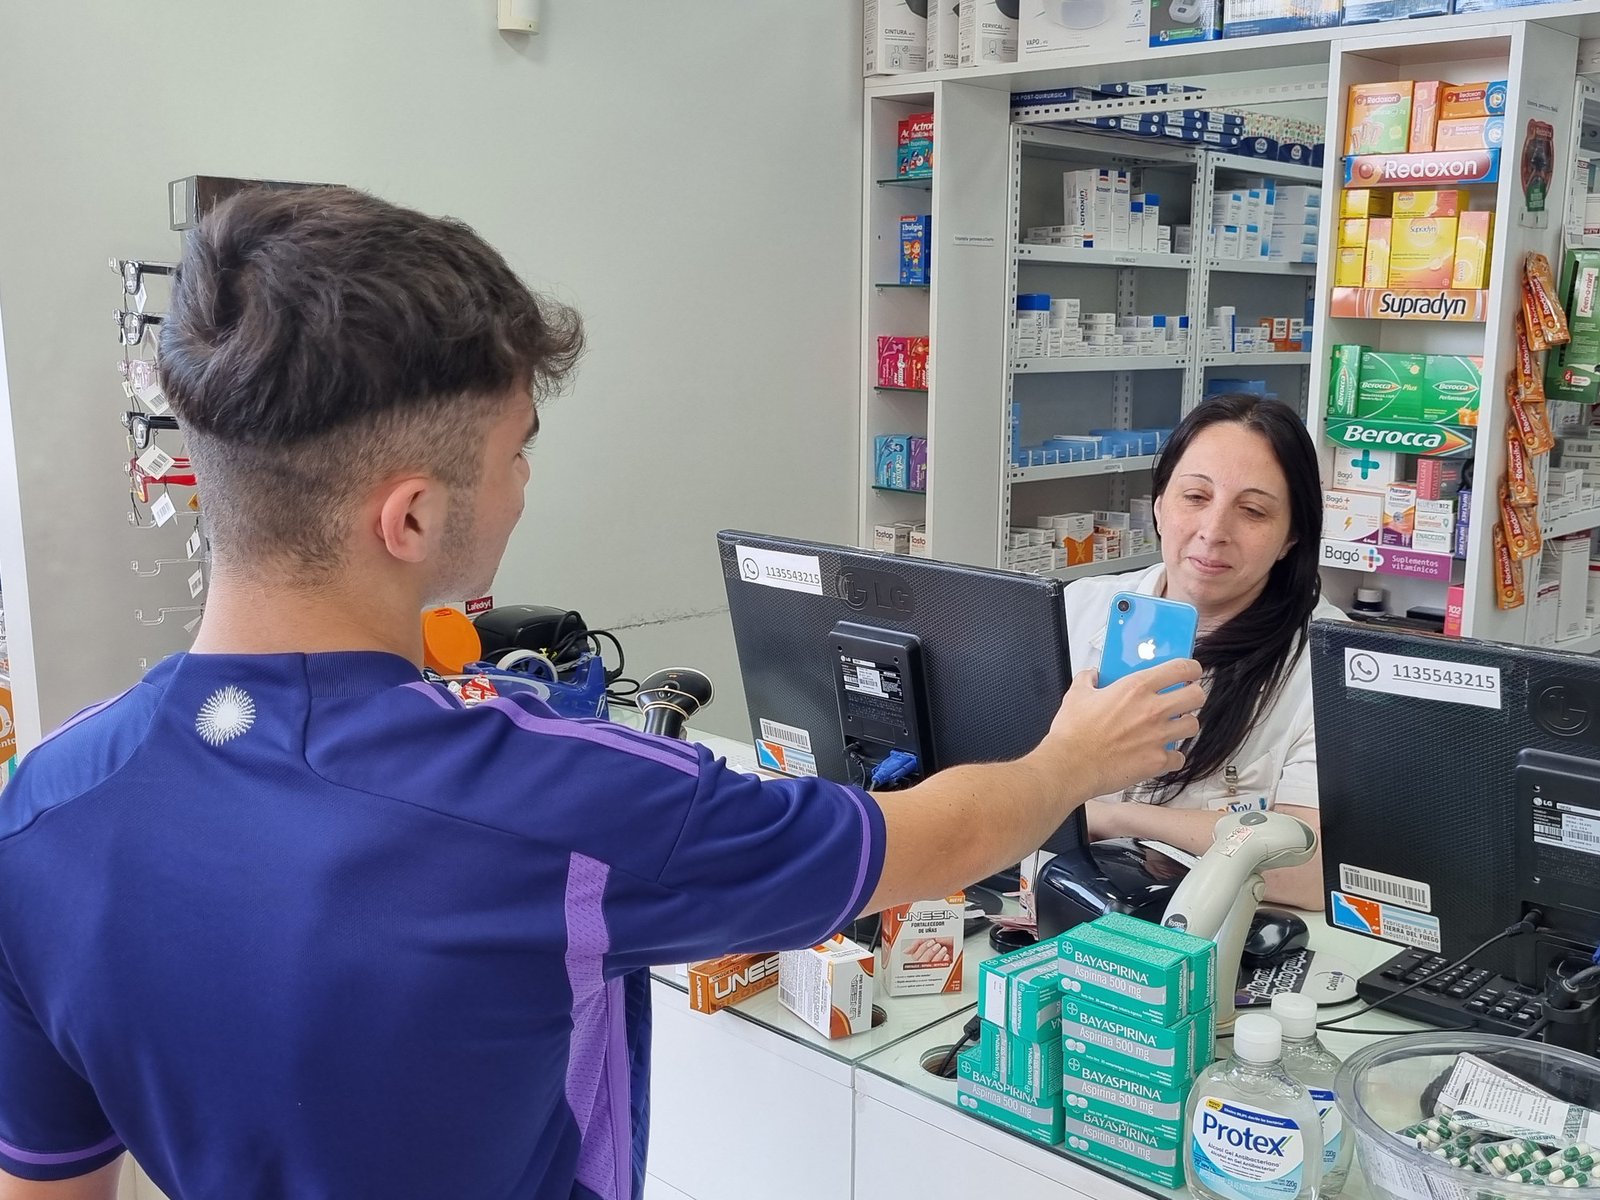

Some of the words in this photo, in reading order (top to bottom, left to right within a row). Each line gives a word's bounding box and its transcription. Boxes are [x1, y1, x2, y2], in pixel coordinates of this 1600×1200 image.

[981, 22, 1004, 30] CERVICAL
[1366, 94, 1398, 105] Redoxon
[1384, 158, 1477, 179] Redoxon
[1409, 225, 1436, 234] Supradyn
[1379, 292, 1467, 320] Supradyn
[1338, 375, 1346, 406] Berocca
[1361, 381, 1392, 390] Berocca
[1439, 383, 1469, 391] Berocca
[1343, 425, 1442, 448] Berocca
[1513, 440, 1525, 481] Redoxitos
[1325, 495, 1343, 504] Bagó
[911, 535, 926, 545] Tosto
[1324, 545, 1360, 565] Bagó
[1392, 554, 1439, 567] Suplementos
[1503, 546, 1514, 586] Redoxitos
[765, 566, 821, 586] 1135543215
[1391, 562, 1438, 575] vitamínicos
[1392, 664, 1496, 690] 1135543215
[896, 910, 959, 922] UNESIA
[1383, 924, 1404, 935] TIERRA
[1406, 930, 1418, 938] DEL
[1419, 932, 1440, 944] FUEGO
[714, 953, 780, 1000] UNES
[1074, 950, 1150, 985] BAYASPIRINA
[1074, 965, 1107, 984] Aspirina
[1109, 976, 1127, 992] 500
[1128, 985, 1142, 999] mg
[849, 973, 859, 1021] UNESIA
[1080, 1012, 1157, 1047] BAYASPIRINA
[1079, 1026, 1113, 1046] Aspirina
[1115, 1038, 1133, 1054] 500
[1135, 1047, 1150, 1061] mg
[972, 1070, 1039, 1106] BAYASPIRINA
[1081, 1067, 1162, 1101] BAYASPIRINA
[972, 1084, 1001, 1104] Aspirina
[1003, 1095, 1018, 1111] 500
[1020, 1104, 1032, 1119] mg
[1081, 1081, 1117, 1101] Aspirina
[1119, 1092, 1137, 1108] 500
[1139, 1100, 1154, 1115] mg
[1083, 1113, 1159, 1147] BAYASPIRINA
[1202, 1111, 1287, 1158] Protex
[1082, 1124, 1116, 1145] Aspirina
[1117, 1136, 1135, 1152] 500
[1137, 1145, 1151, 1161] mg
[1210, 1150, 1227, 1160] Alcohol
[1224, 1149, 1235, 1157] Gel
[1234, 1152, 1280, 1168] Antibacteriano
[1325, 1150, 1337, 1160] 220g
[1285, 1180, 1298, 1190] 220g
